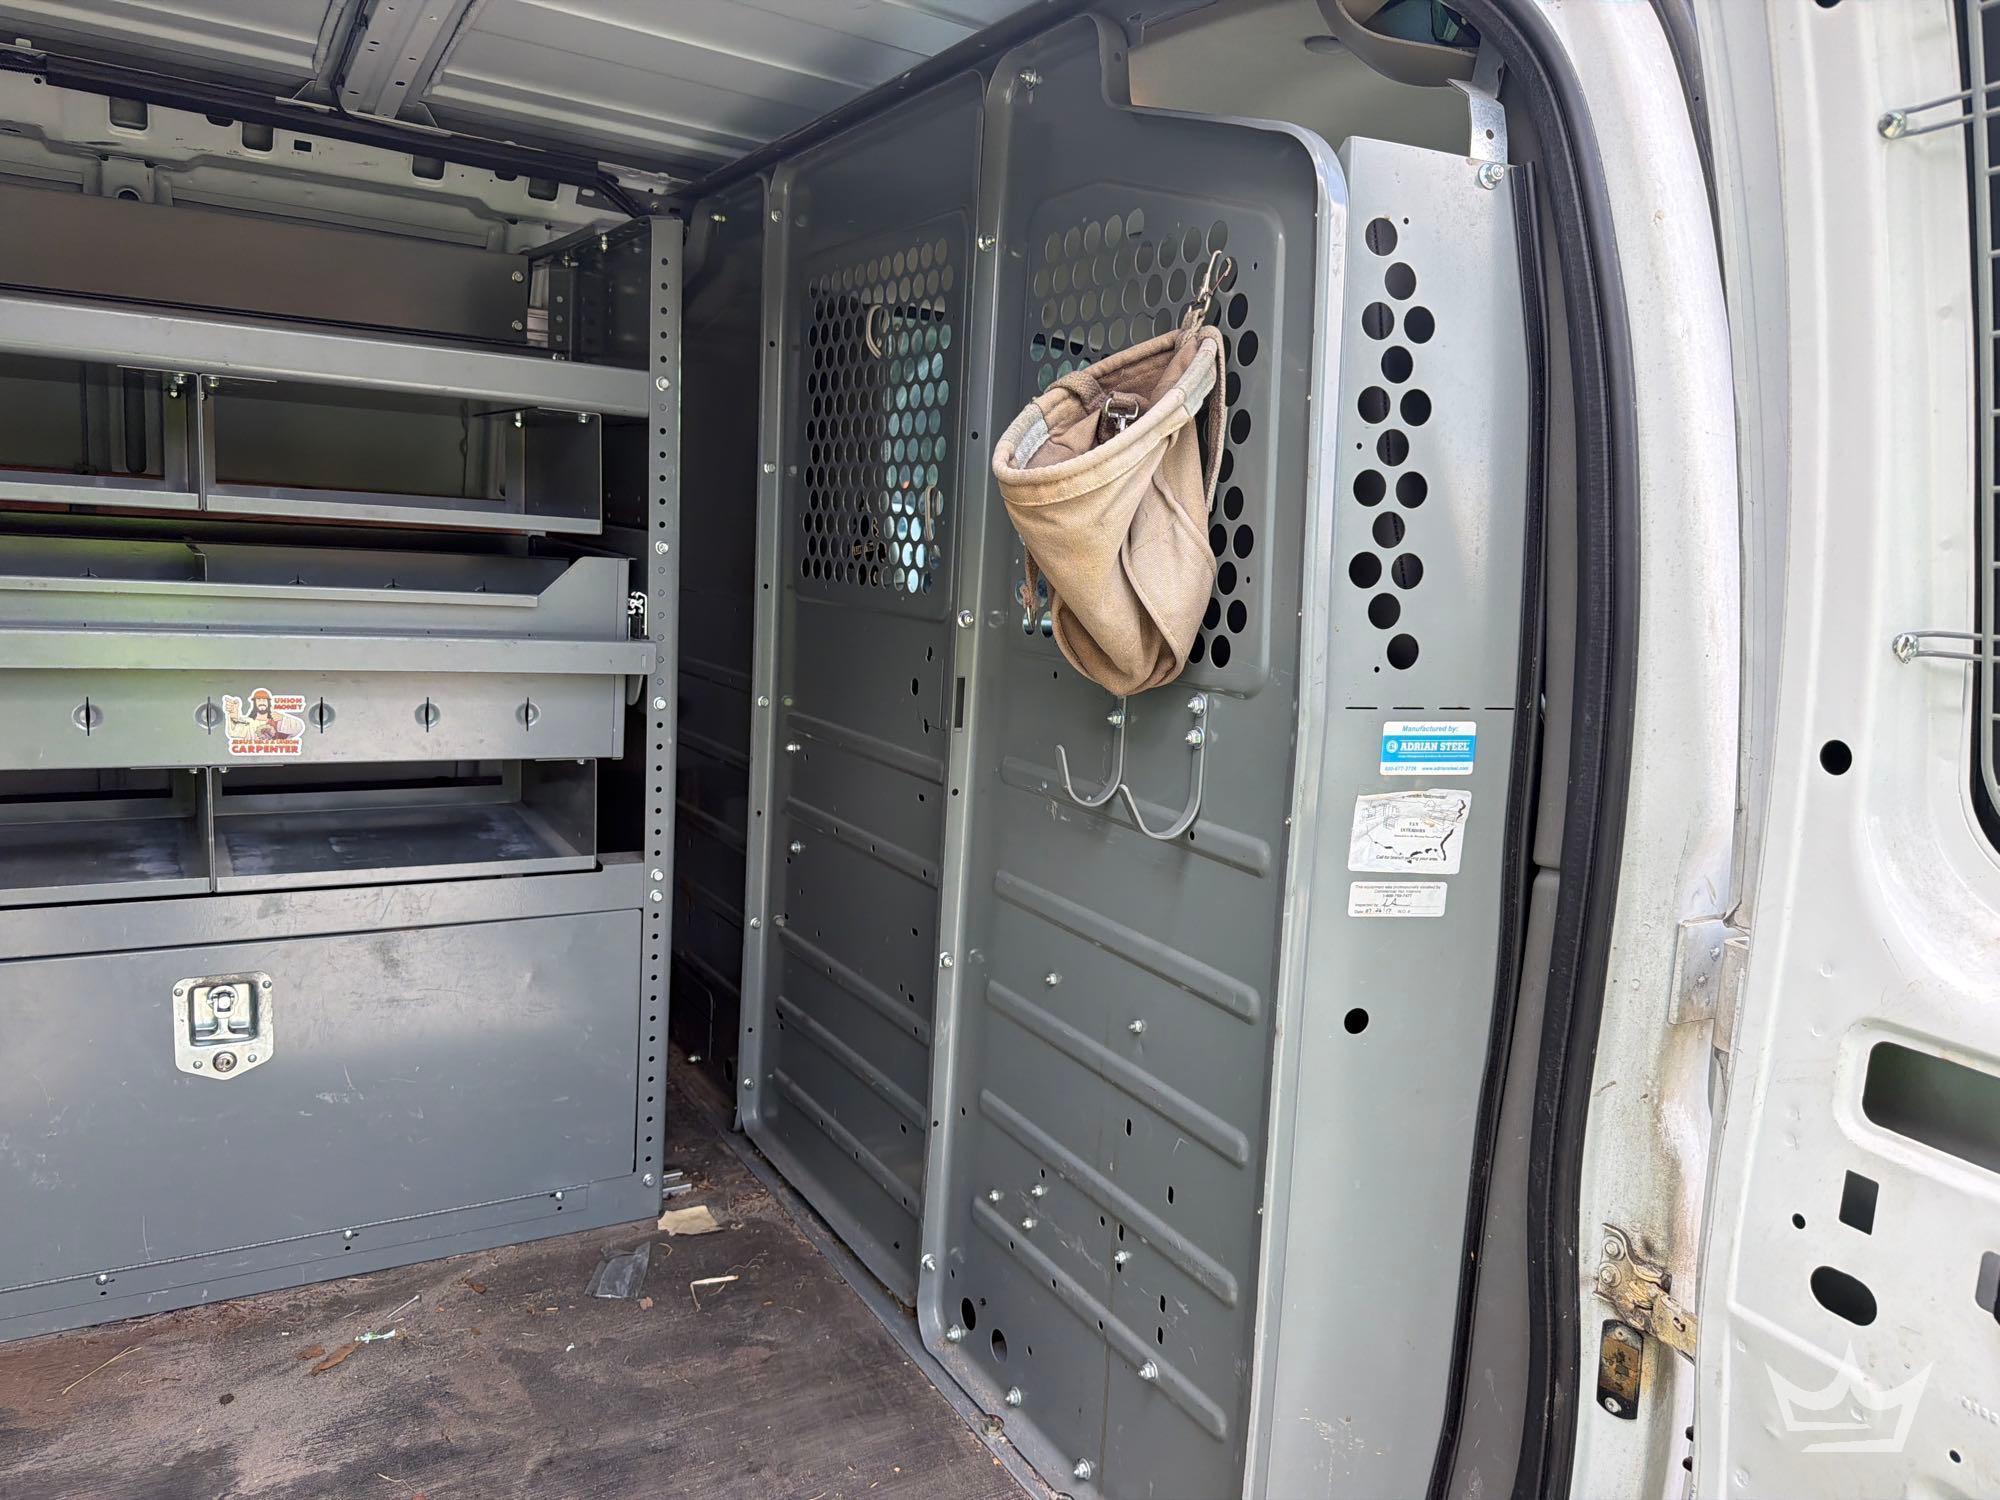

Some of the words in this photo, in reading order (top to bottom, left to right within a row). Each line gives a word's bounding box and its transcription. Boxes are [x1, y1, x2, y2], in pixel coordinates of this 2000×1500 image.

[1448, 725, 1458, 733] by:
[232, 745, 299, 753] CARPENTER
[1400, 741, 1438, 751] ADRIAN
[1440, 741, 1470, 751] STEEL
